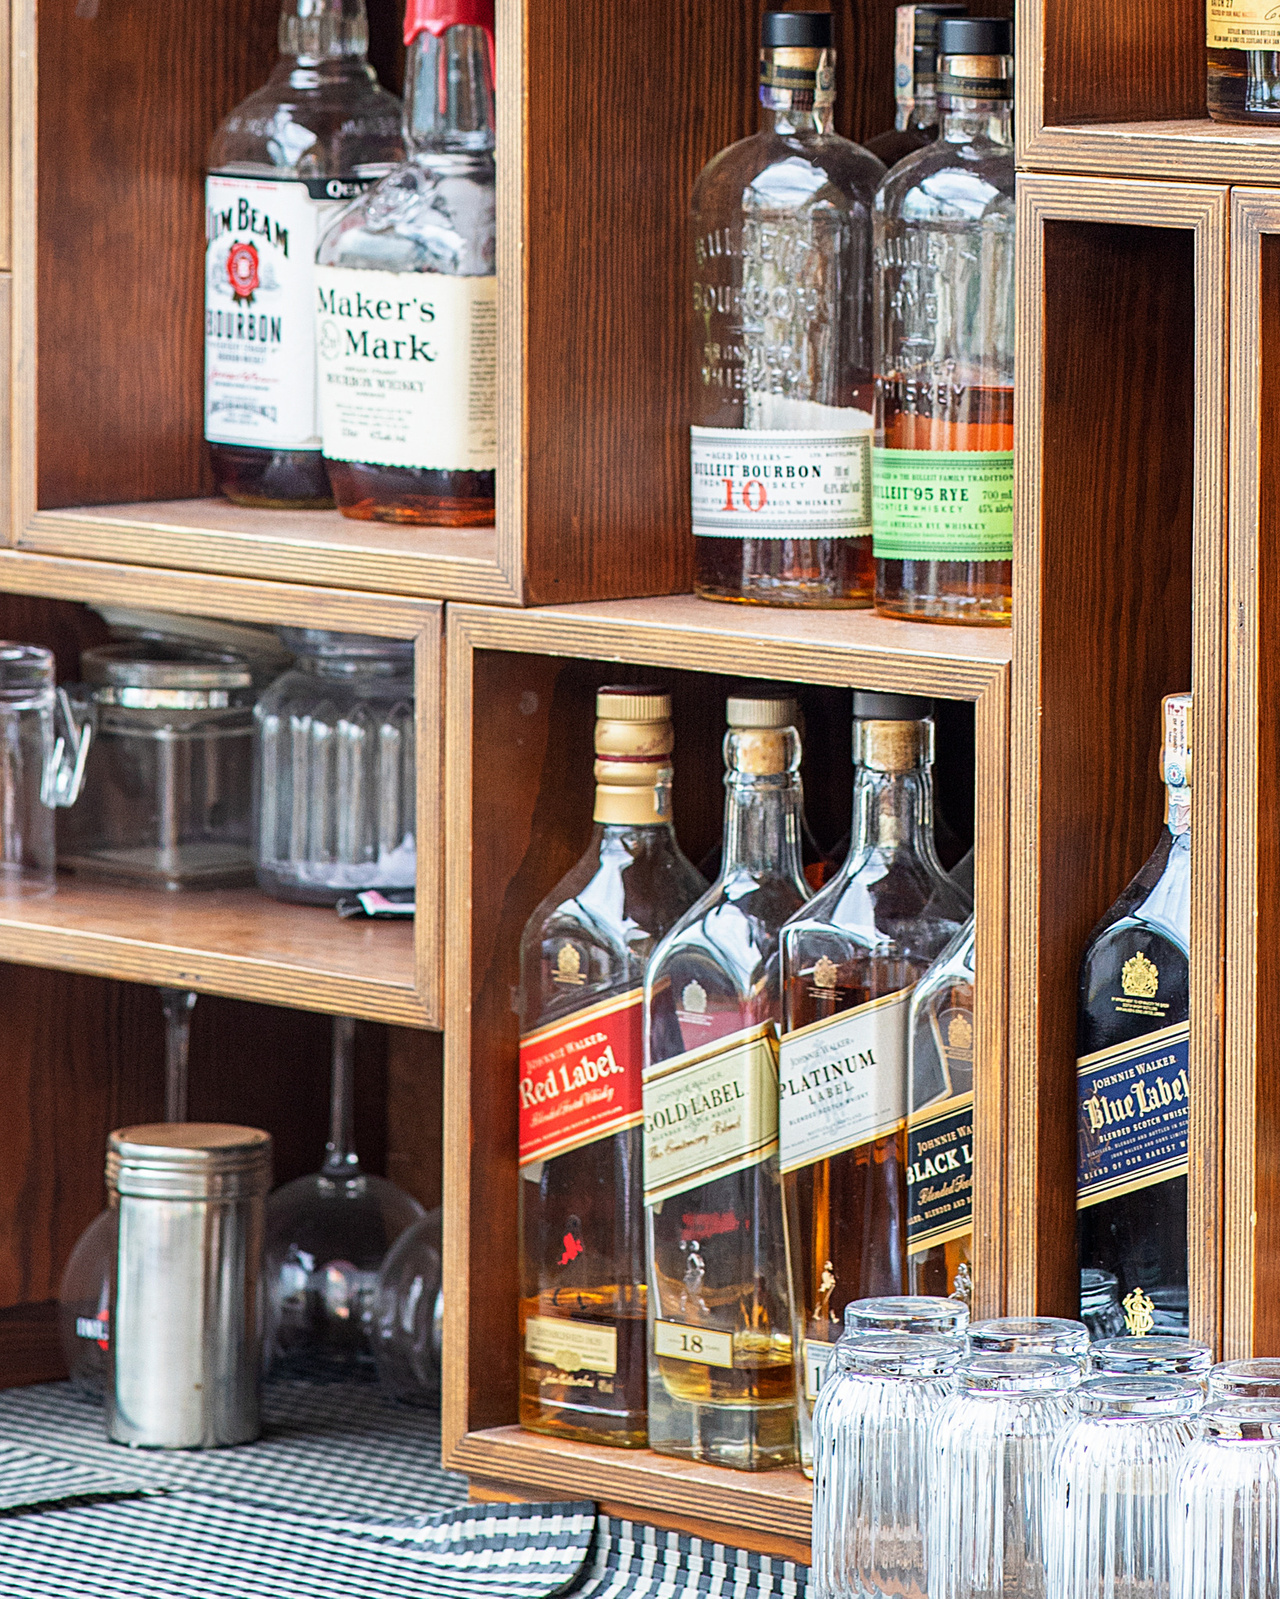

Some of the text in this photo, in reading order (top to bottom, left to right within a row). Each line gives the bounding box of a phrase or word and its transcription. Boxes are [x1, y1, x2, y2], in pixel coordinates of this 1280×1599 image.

[237, 198, 289, 259] BEAM
[317, 286, 436, 323] Maker's
[206, 309, 282, 343] BOURBON
[345, 329, 435, 362] Mark
[742, 465, 822, 478] BOURBON
[722, 479, 767, 512] 10
[914, 487, 999, 502] 95 RYE 700
[520, 1070, 560, 1109] Red
[779, 1049, 877, 1101] PLATINUM
[1092, 1055, 1176, 1094] JOHNNIE WALKER
[643, 1102, 688, 1134] GOLD
[690, 1081, 745, 1116] LABEL
[808, 1081, 851, 1105] LABEL
[1083, 1068, 1190, 1134] Blue Label
[917, 1129, 958, 1157] JOHNNIE
[1099, 1126, 1131, 1143] BLENDED
[1133, 1117, 1161, 1132] SCOTCH
[1114, 1126, 1170, 1149] BLENDED AND BOTTLED
[907, 1151, 961, 1185] BLACK
[1084, 1144, 1176, 1180] BLEND OF OUR RAREST
[678, 1333, 704, 1354] 18
